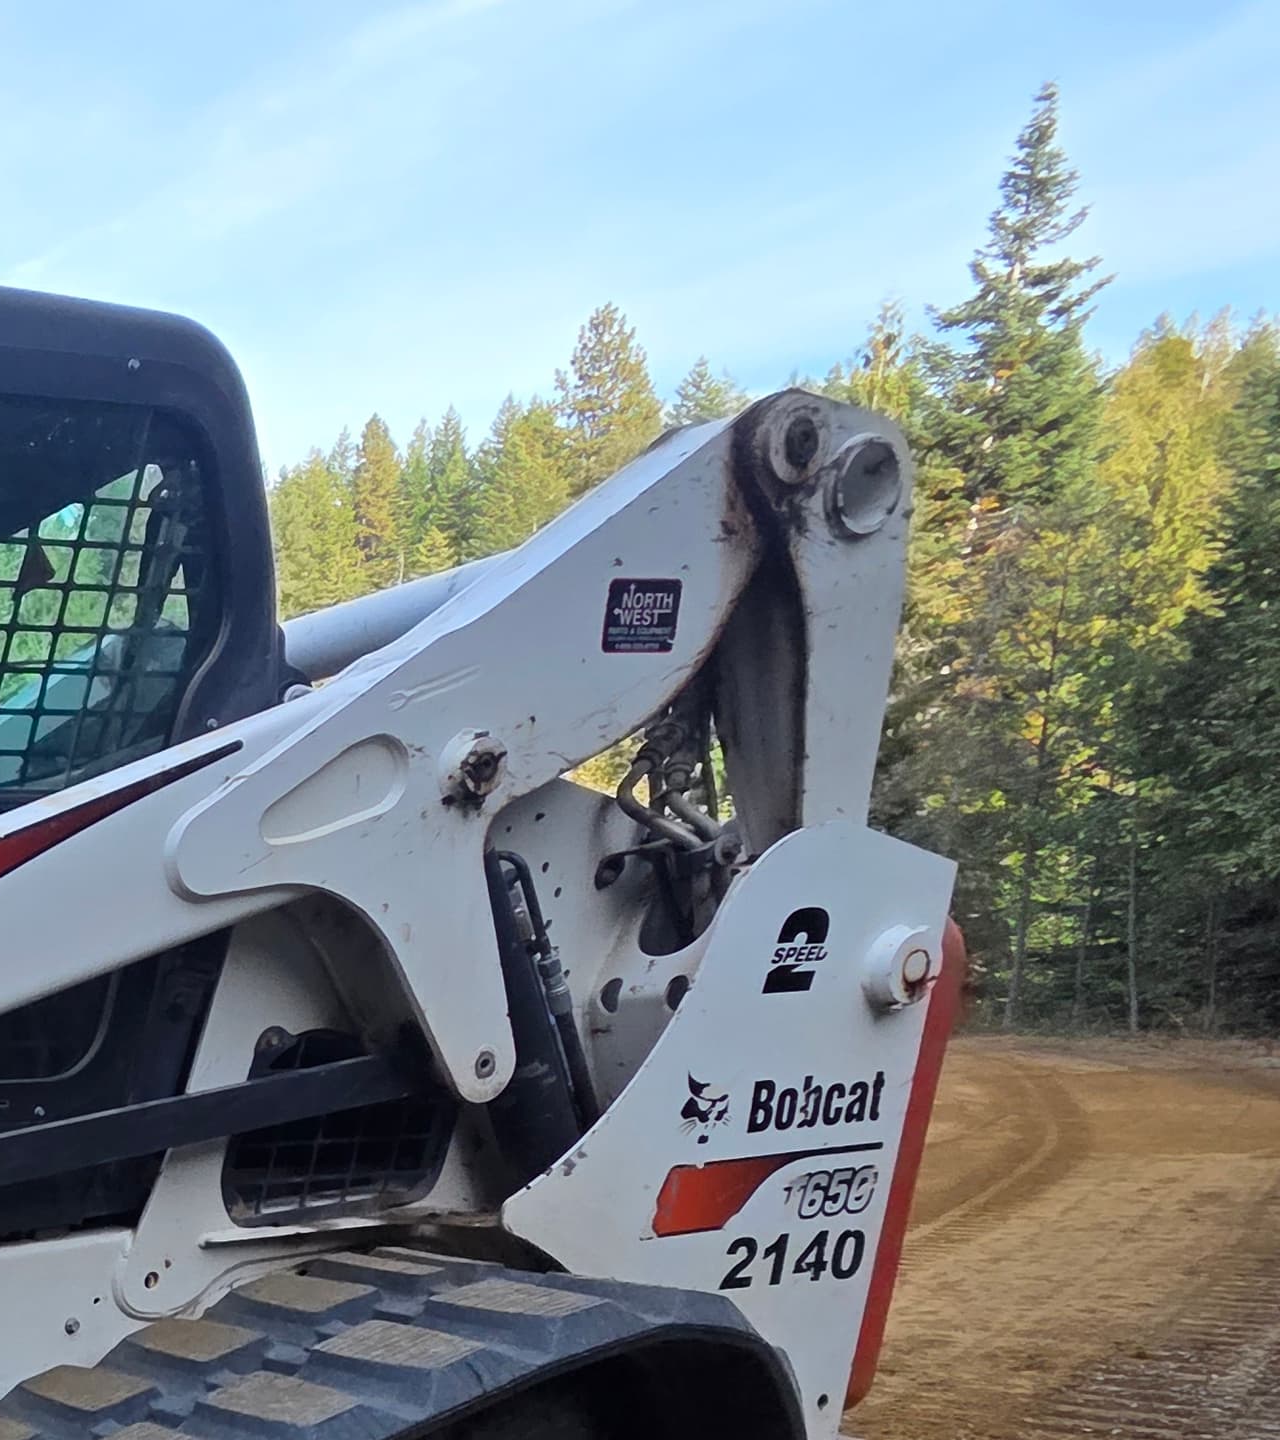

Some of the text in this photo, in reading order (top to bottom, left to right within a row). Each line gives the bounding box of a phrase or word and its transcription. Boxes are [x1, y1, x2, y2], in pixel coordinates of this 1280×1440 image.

[616, 608, 671, 625] WEST
[621, 589, 674, 609] NORTH
[761, 906, 830, 995] 2
[771, 946, 828, 964] SPEED
[747, 1070, 885, 1134] Bobcat
[719, 1229, 866, 1290] 2140
